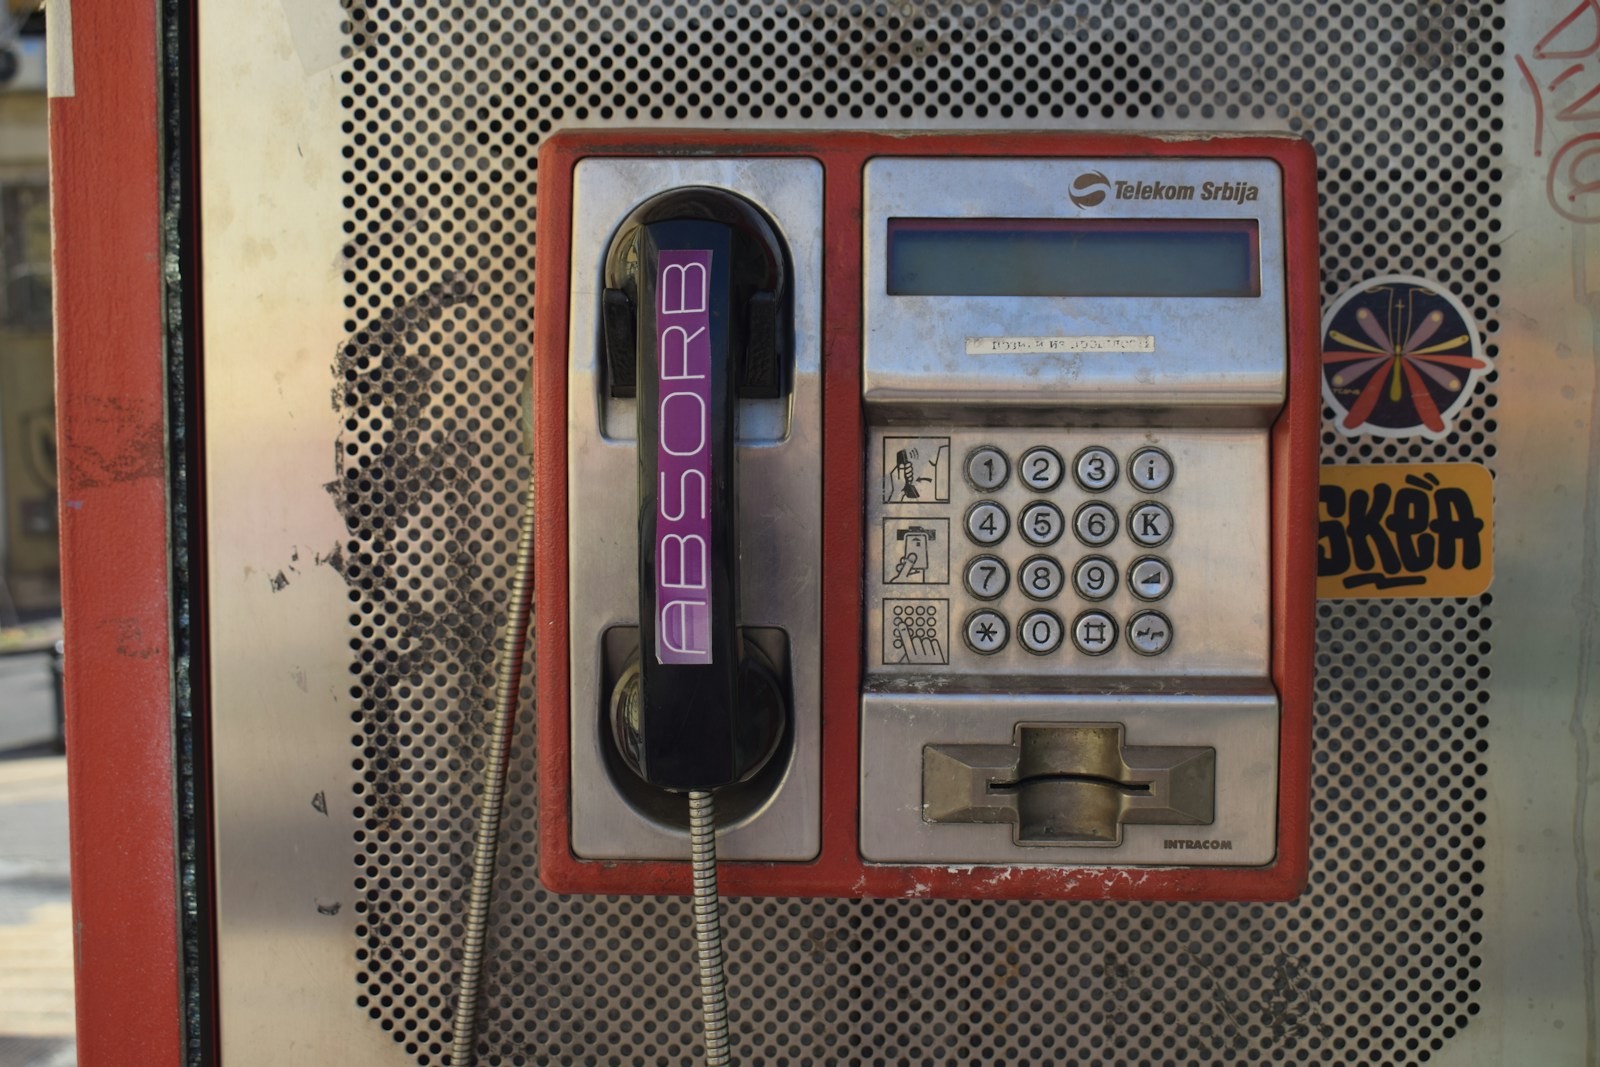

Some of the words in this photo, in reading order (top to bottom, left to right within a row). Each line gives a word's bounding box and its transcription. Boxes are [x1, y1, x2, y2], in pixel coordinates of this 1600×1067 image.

[1115, 181, 1195, 200] Telekom
[1200, 181, 1259, 205] Srbija
[661, 262, 706, 654] ABSORB
[984, 458, 993, 481] 1
[1032, 458, 1049, 481] 2
[1088, 458, 1105, 481] 3
[1148, 460, 1155, 481] i
[979, 512, 997, 535] 4
[1033, 512, 1051, 536] 5
[1088, 513, 1105, 536] 6
[1141, 513, 1161, 536] K
[980, 566, 996, 590] 7
[1033, 567, 1050, 590] 8
[1087, 566, 1105, 590] 9
[1032, 621, 1050, 644] 0
[1163, 839, 1232, 850] INTRACOM
